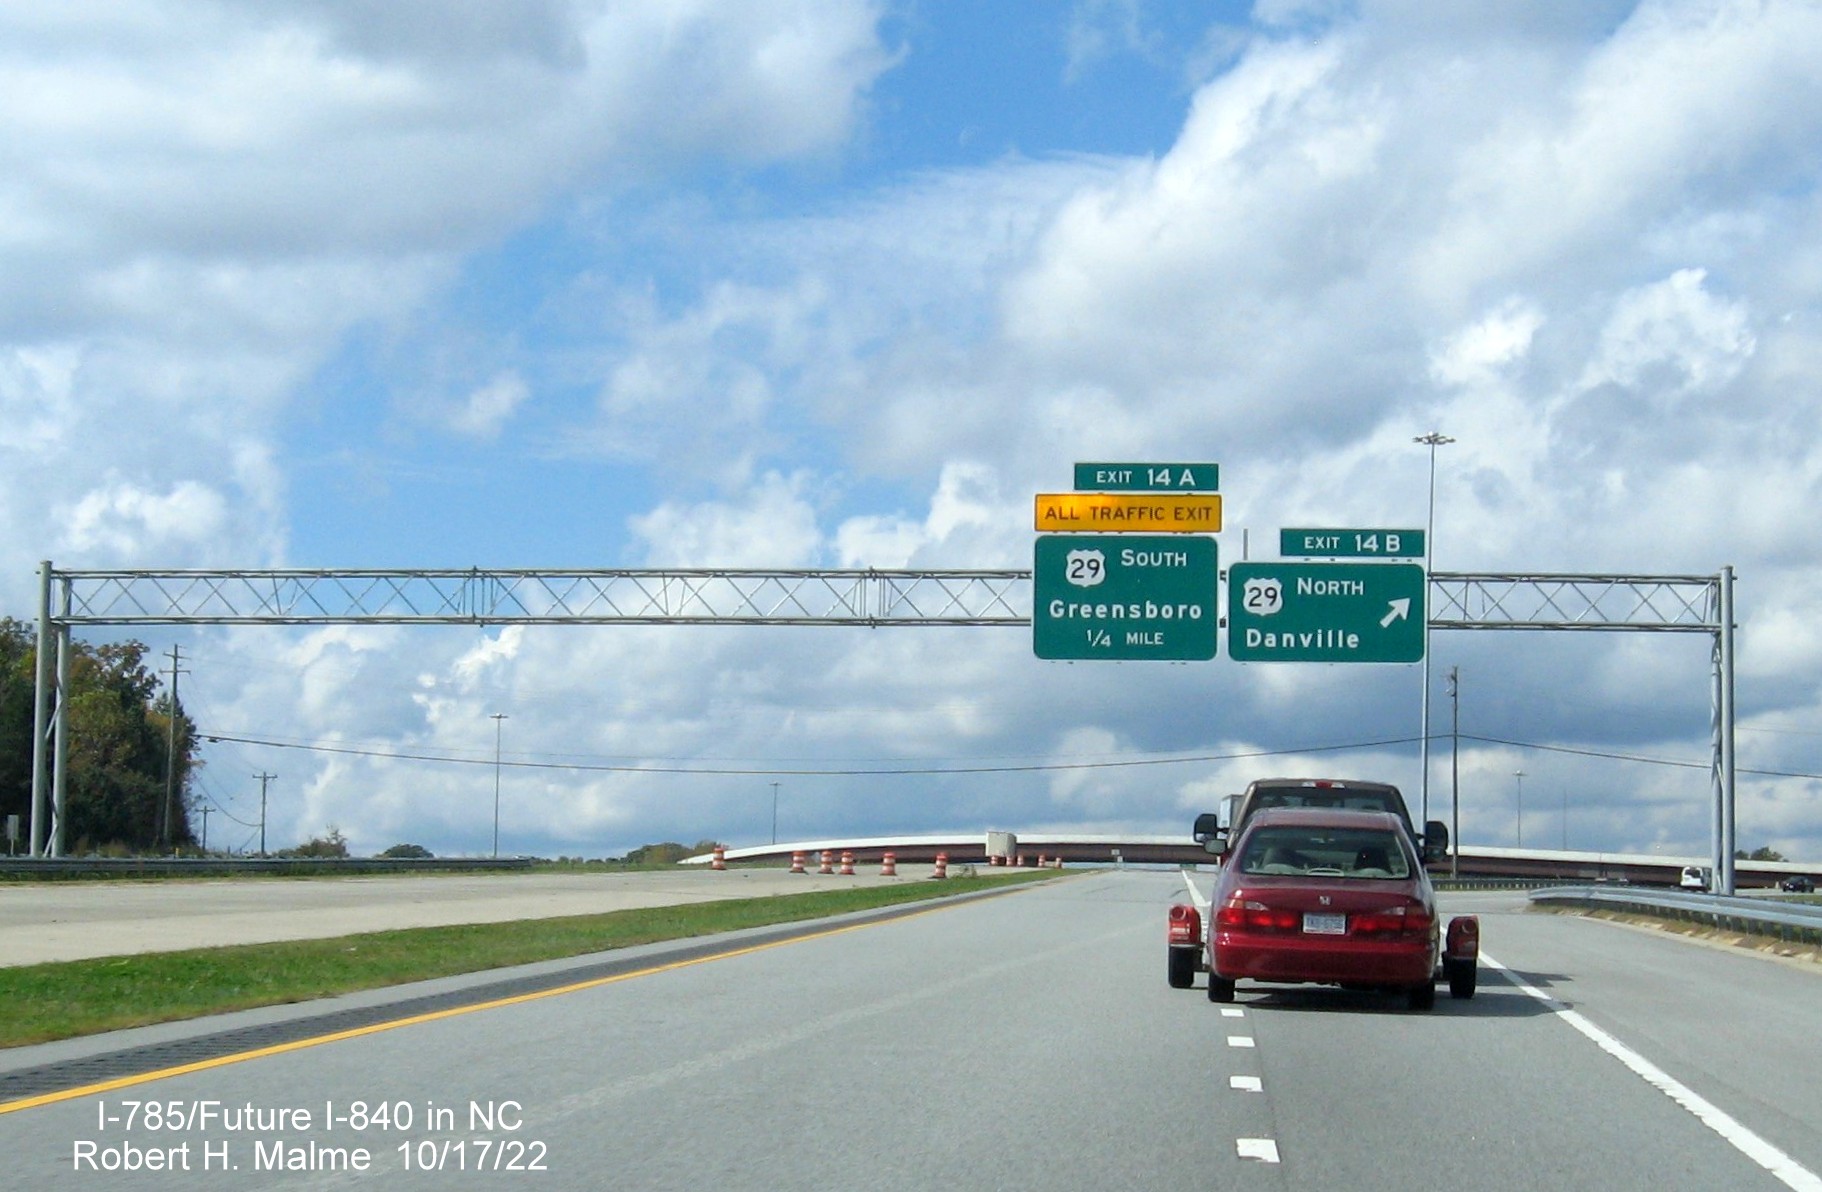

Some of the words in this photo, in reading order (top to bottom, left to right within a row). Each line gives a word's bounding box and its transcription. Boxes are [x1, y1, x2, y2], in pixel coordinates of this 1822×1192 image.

[1096, 471, 1132, 483] EXIT
[1147, 469, 1172, 486] 14
[1179, 469, 1196, 486] A
[1045, 506, 1079, 521] ALL
[1090, 506, 1164, 521] TRAFFIC
[1174, 507, 1212, 521] EXIT
[1304, 537, 1340, 549] EXIT
[1355, 535, 1379, 552] 14
[1385, 535, 1400, 552] B
[1070, 559, 1101, 578] 29
[1248, 587, 1277, 607] 29
[1050, 600, 1201, 618] Greensboro
[1126, 632, 1164, 645] MILE
[1247, 629, 1359, 648] Danville
